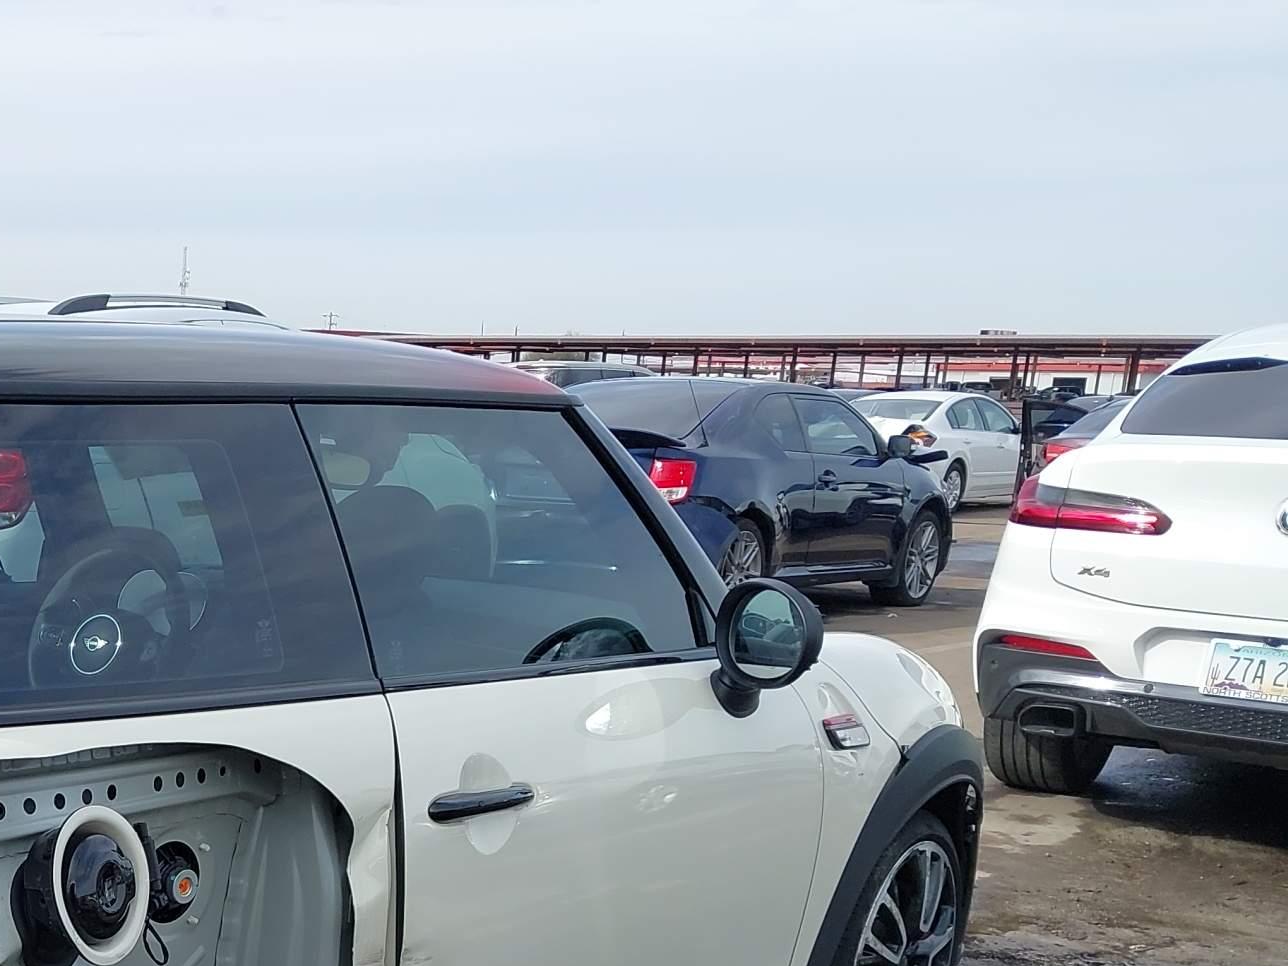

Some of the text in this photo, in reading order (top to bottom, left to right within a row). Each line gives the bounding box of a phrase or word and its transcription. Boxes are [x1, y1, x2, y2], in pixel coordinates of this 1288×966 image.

[1077, 565, 1111, 578] X4
[1224, 655, 1267, 685] Z7A
[1202, 686, 1242, 698] NORTH
